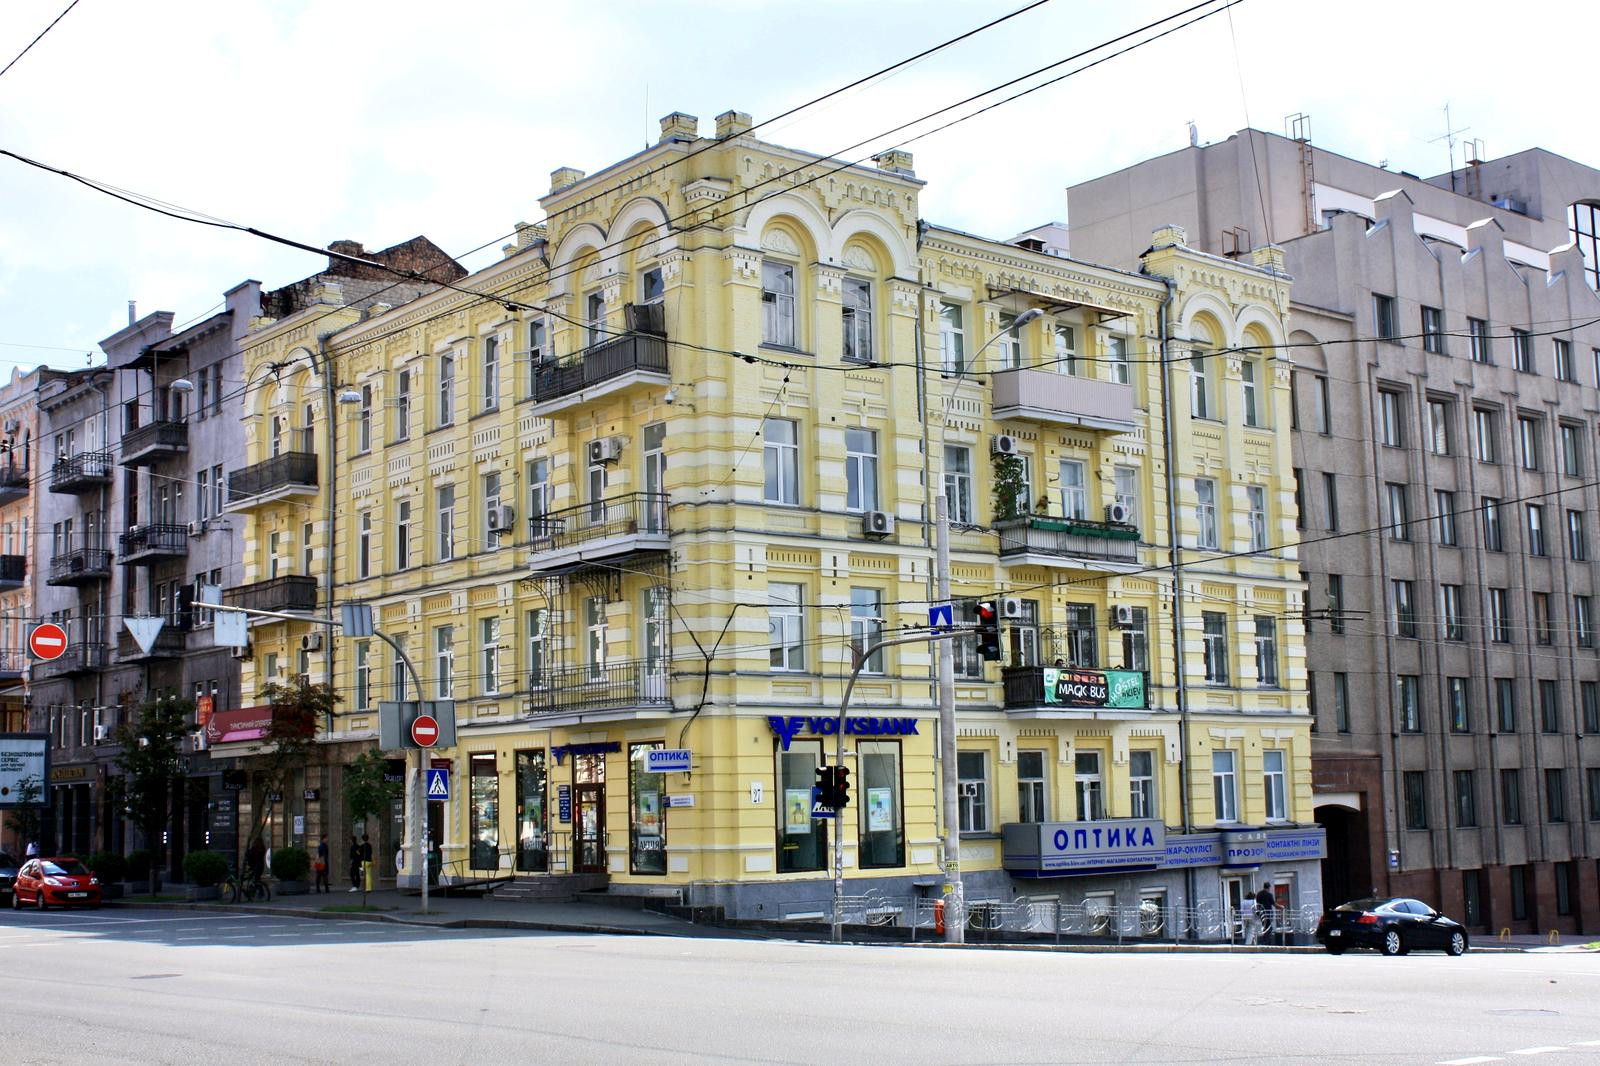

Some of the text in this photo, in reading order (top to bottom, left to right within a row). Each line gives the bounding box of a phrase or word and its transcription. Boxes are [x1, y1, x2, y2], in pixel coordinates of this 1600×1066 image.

[1089, 686, 1106, 698] BUS
[1111, 677, 1140, 702] HOSTEL
[1126, 687, 1141, 697] KIEV
[650, 752, 689, 761] ОПТИКА
[753, 788, 761, 803] 27
[1053, 826, 1154, 851] ОПТИКА
[1302, 839, 1320, 847] ЛІНЗИ
[1166, 845, 1212, 855] ІКАР-ОКУЛІСТ
[1228, 848, 1264, 857] ПРОЗОР
